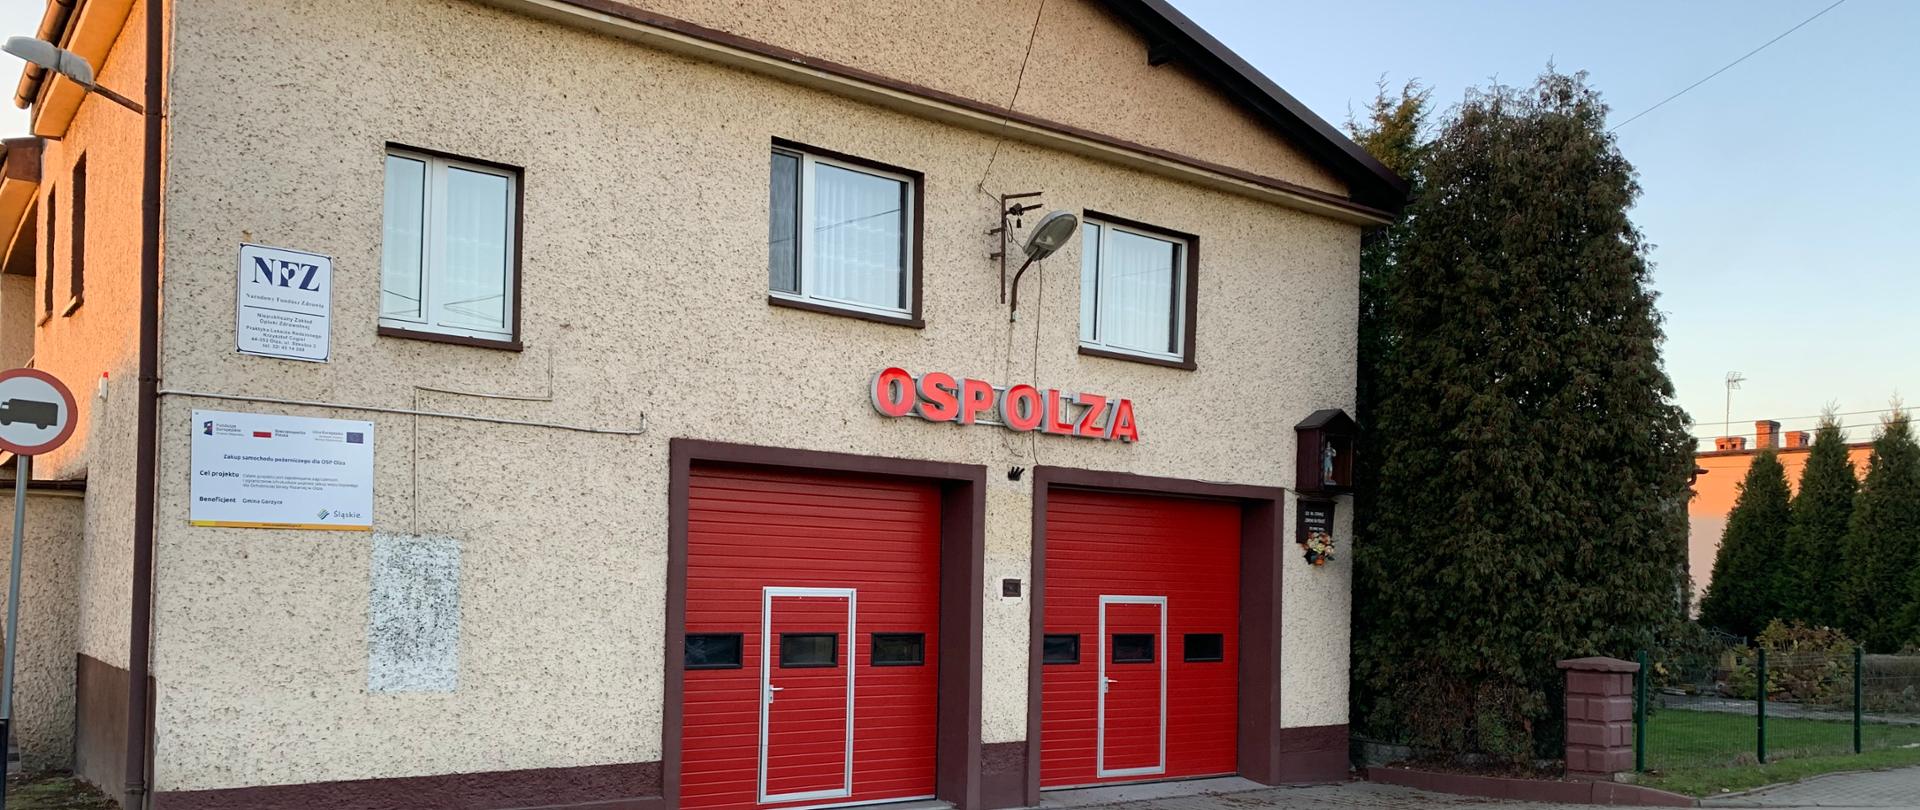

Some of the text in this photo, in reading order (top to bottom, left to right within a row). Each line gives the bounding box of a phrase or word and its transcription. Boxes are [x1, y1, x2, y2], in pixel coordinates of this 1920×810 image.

[252, 256, 320, 292] NFZ
[276, 297, 300, 305] Fundusz
[301, 300, 324, 309] Zdrowia
[871, 367, 1139, 442] OSP OLZA
[211, 470, 240, 478] projektu
[333, 509, 361, 519] Śląskie
